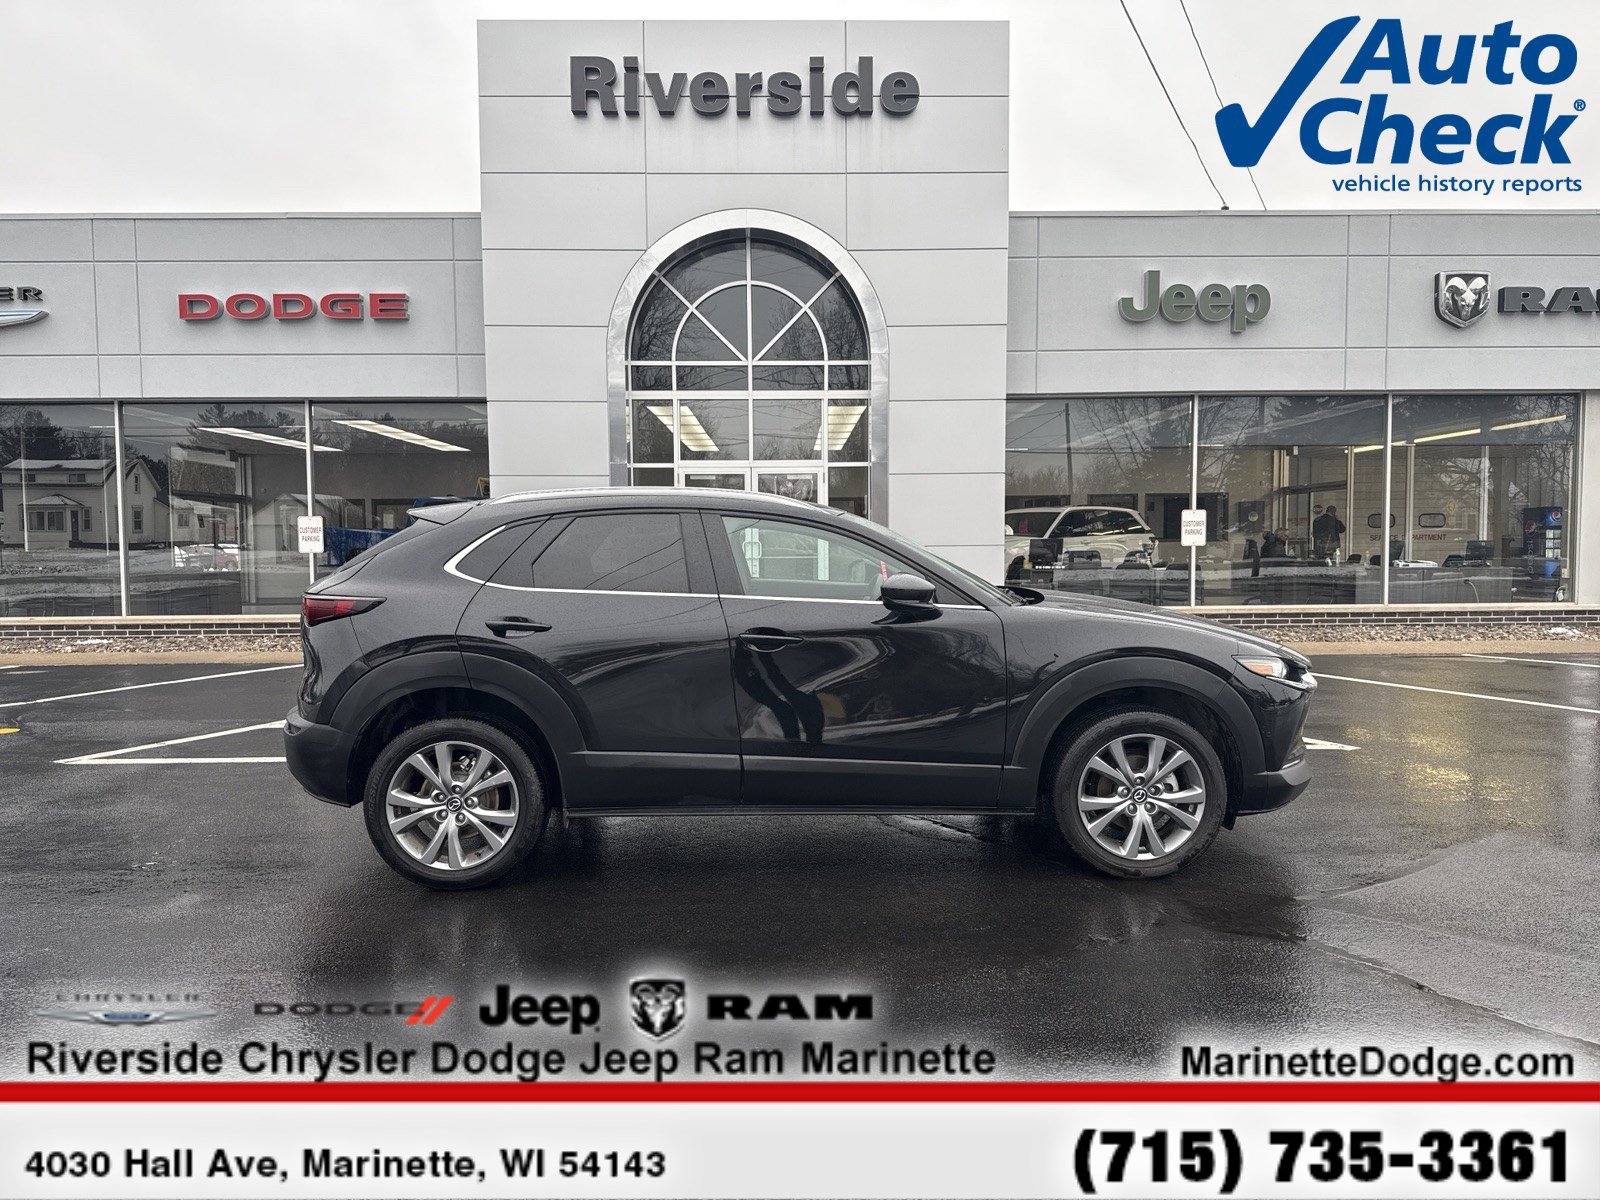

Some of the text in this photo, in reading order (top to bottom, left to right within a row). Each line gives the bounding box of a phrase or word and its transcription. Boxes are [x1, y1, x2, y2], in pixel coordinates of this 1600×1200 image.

[569, 55, 920, 117] Riverside
[178, 293, 410, 321] DODGE
[1118, 269, 1271, 333] Jeep
[1498, 286, 1600, 313] RA
